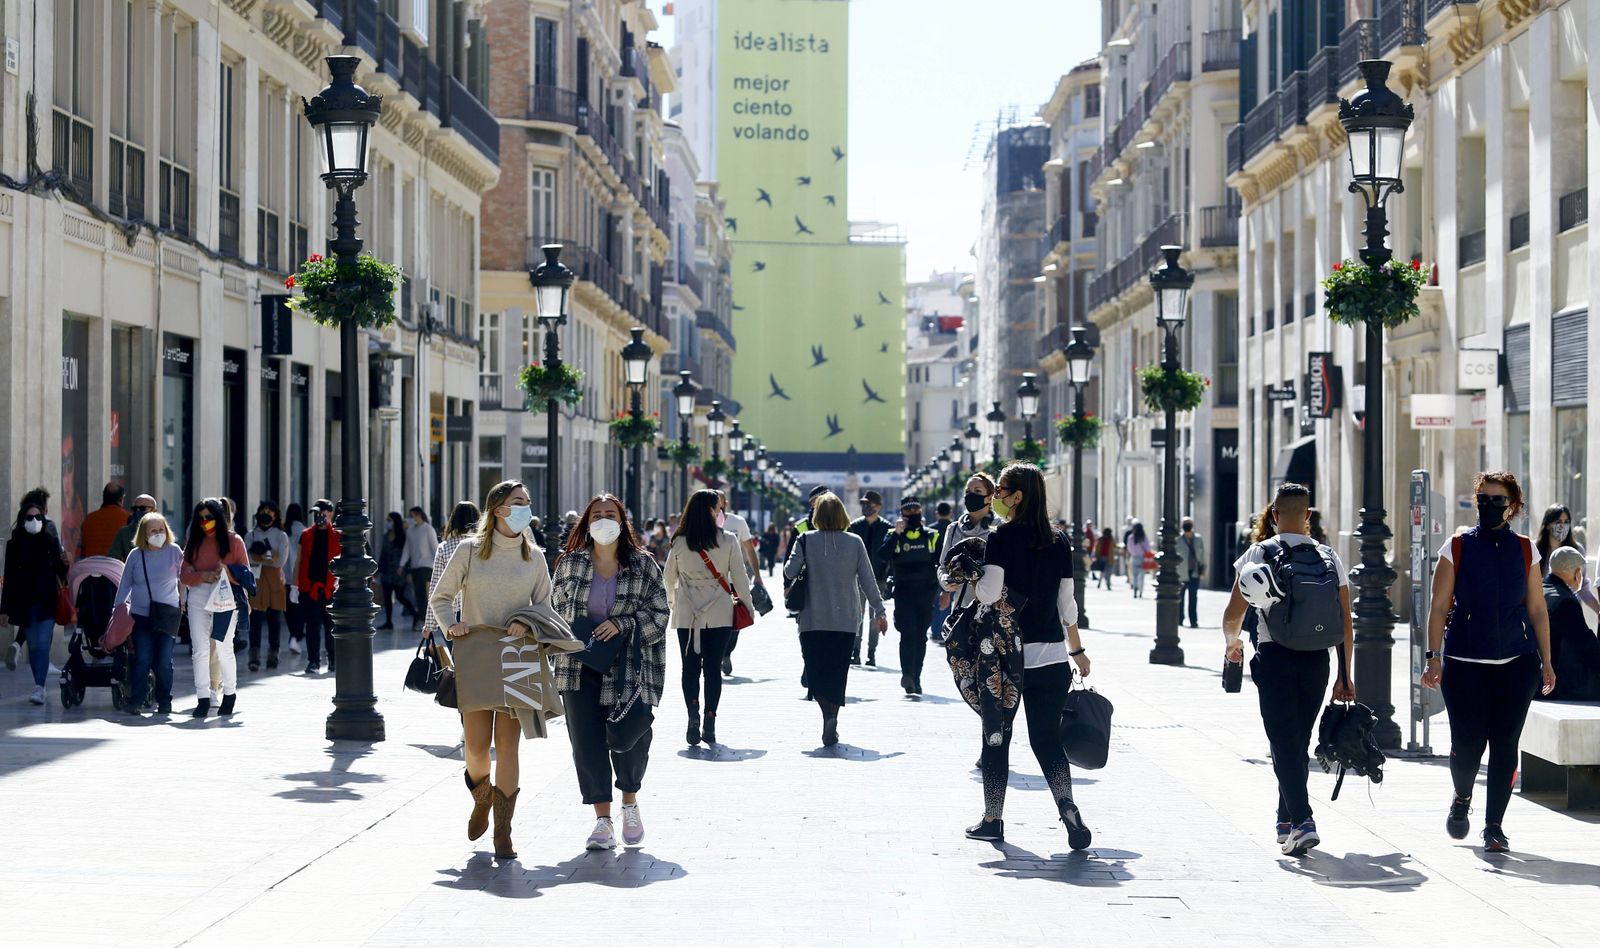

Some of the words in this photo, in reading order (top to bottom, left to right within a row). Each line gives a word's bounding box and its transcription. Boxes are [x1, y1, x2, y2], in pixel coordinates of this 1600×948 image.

[733, 31, 830, 53] idealista
[733, 75, 791, 94] mejor
[733, 98, 793, 117] ciento
[733, 123, 810, 142] volando
[1463, 363, 1496, 376] COS
[1310, 355, 1323, 416] PRIMOR
